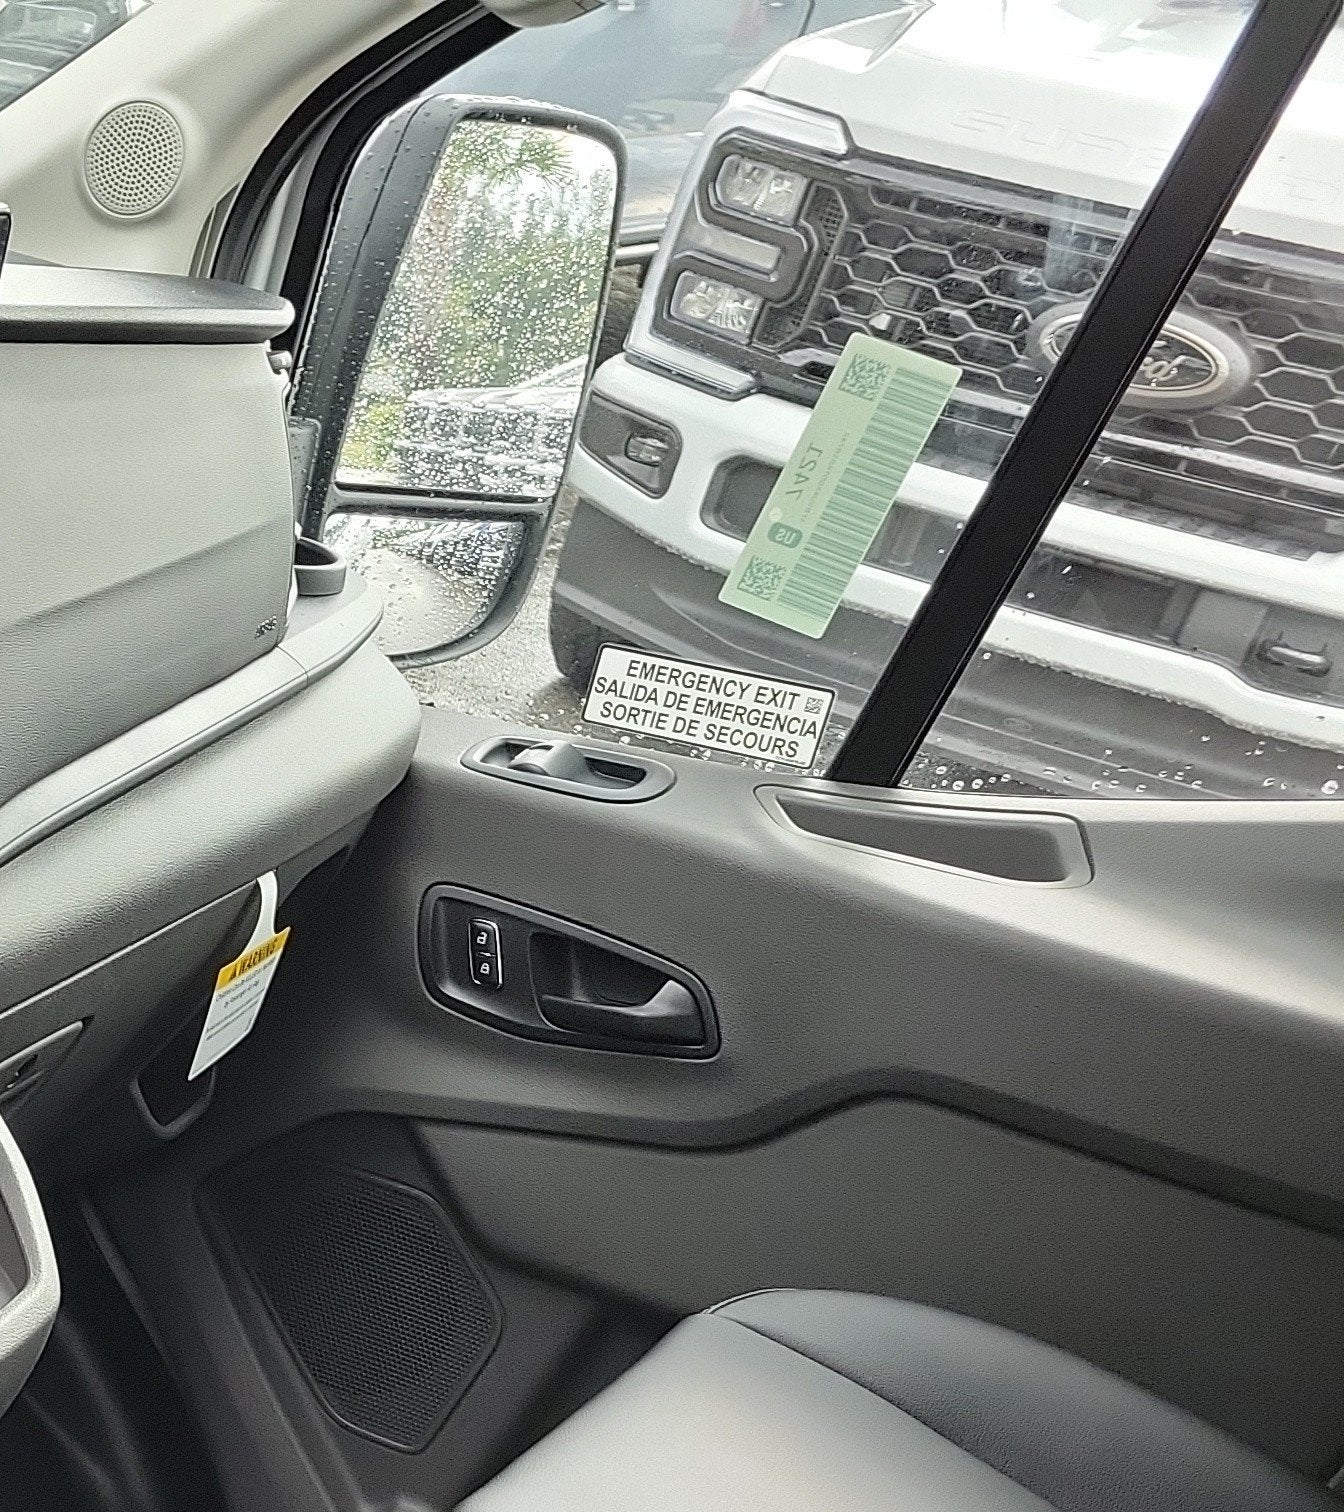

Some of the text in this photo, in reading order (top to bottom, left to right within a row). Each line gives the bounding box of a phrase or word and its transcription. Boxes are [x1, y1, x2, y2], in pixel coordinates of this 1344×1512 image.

[594, 676, 818, 740] SALIDA DE EMERGENCIA
[625, 659, 801, 712] EMERGENCY EXIT
[599, 701, 801, 759] SORTIE DE SECOURS
